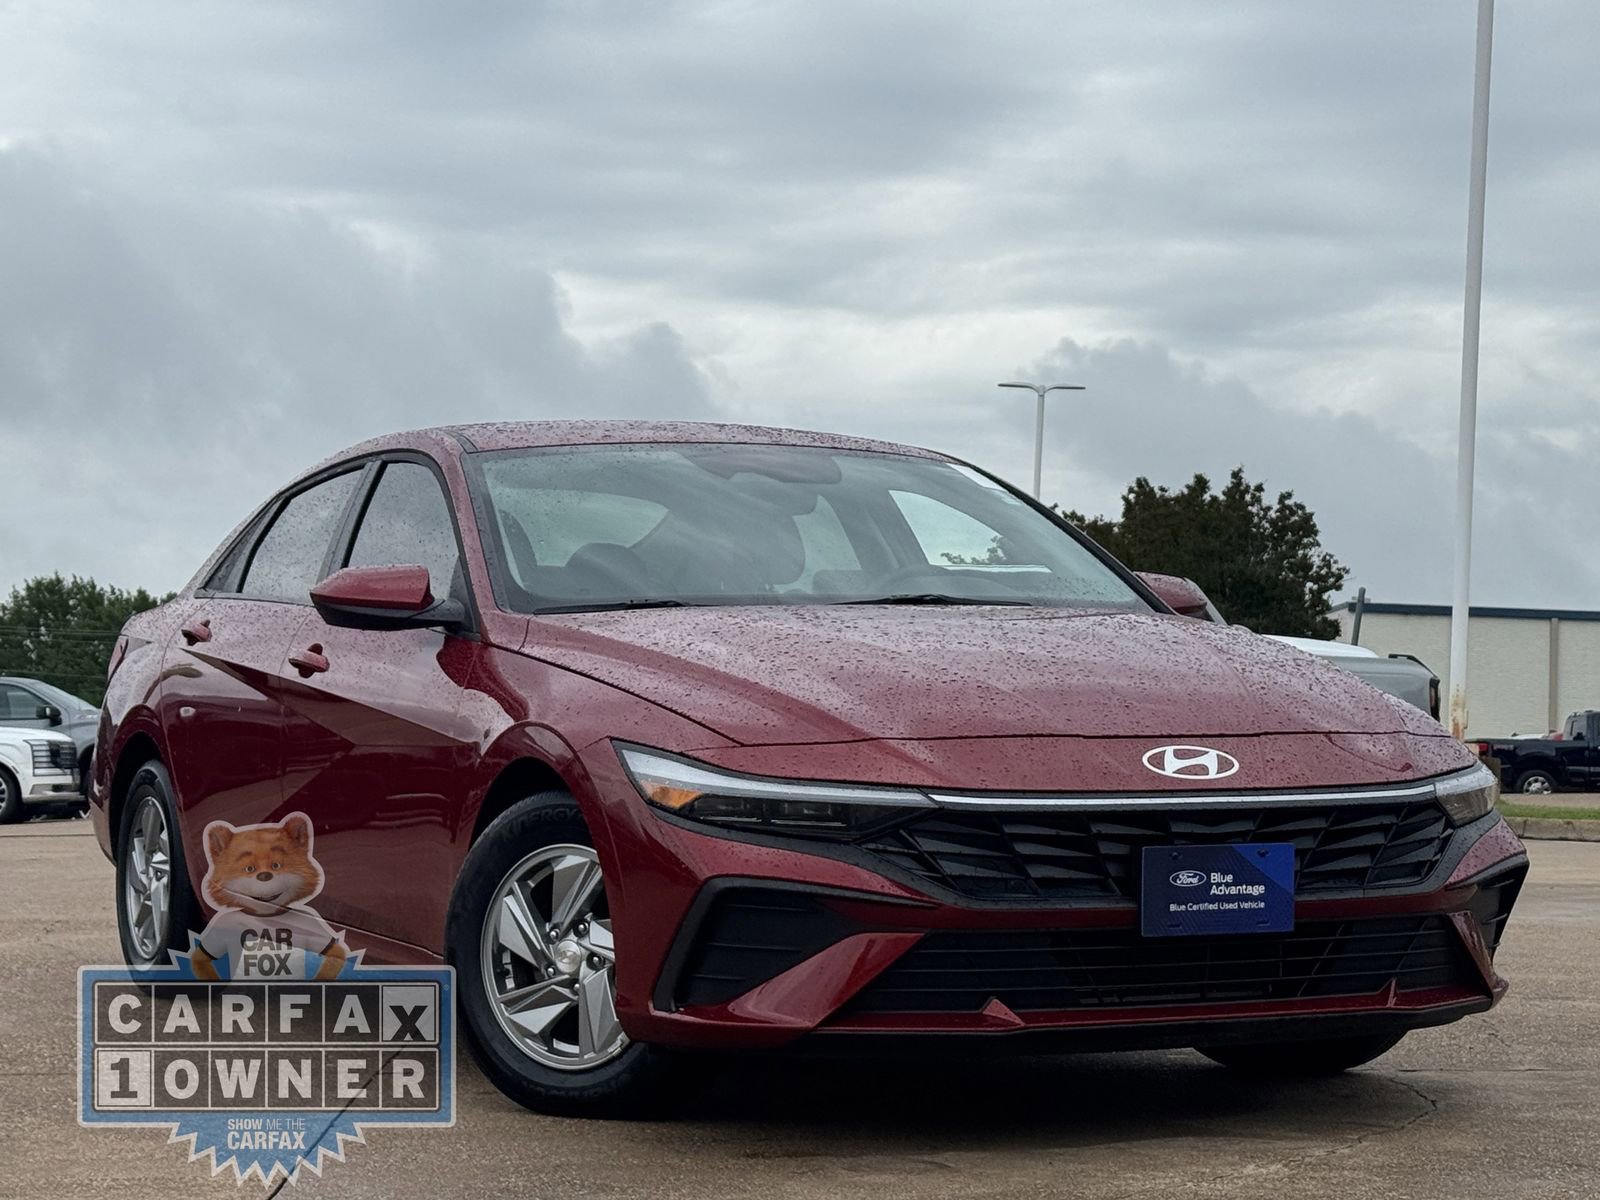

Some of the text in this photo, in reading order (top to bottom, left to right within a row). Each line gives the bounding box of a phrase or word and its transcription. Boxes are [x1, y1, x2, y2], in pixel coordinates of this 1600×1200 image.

[1210, 872, 1234, 883] Blue
[1210, 884, 1266, 896] Advantage
[1169, 900, 1265, 912] Blue Certified Used Vehicle
